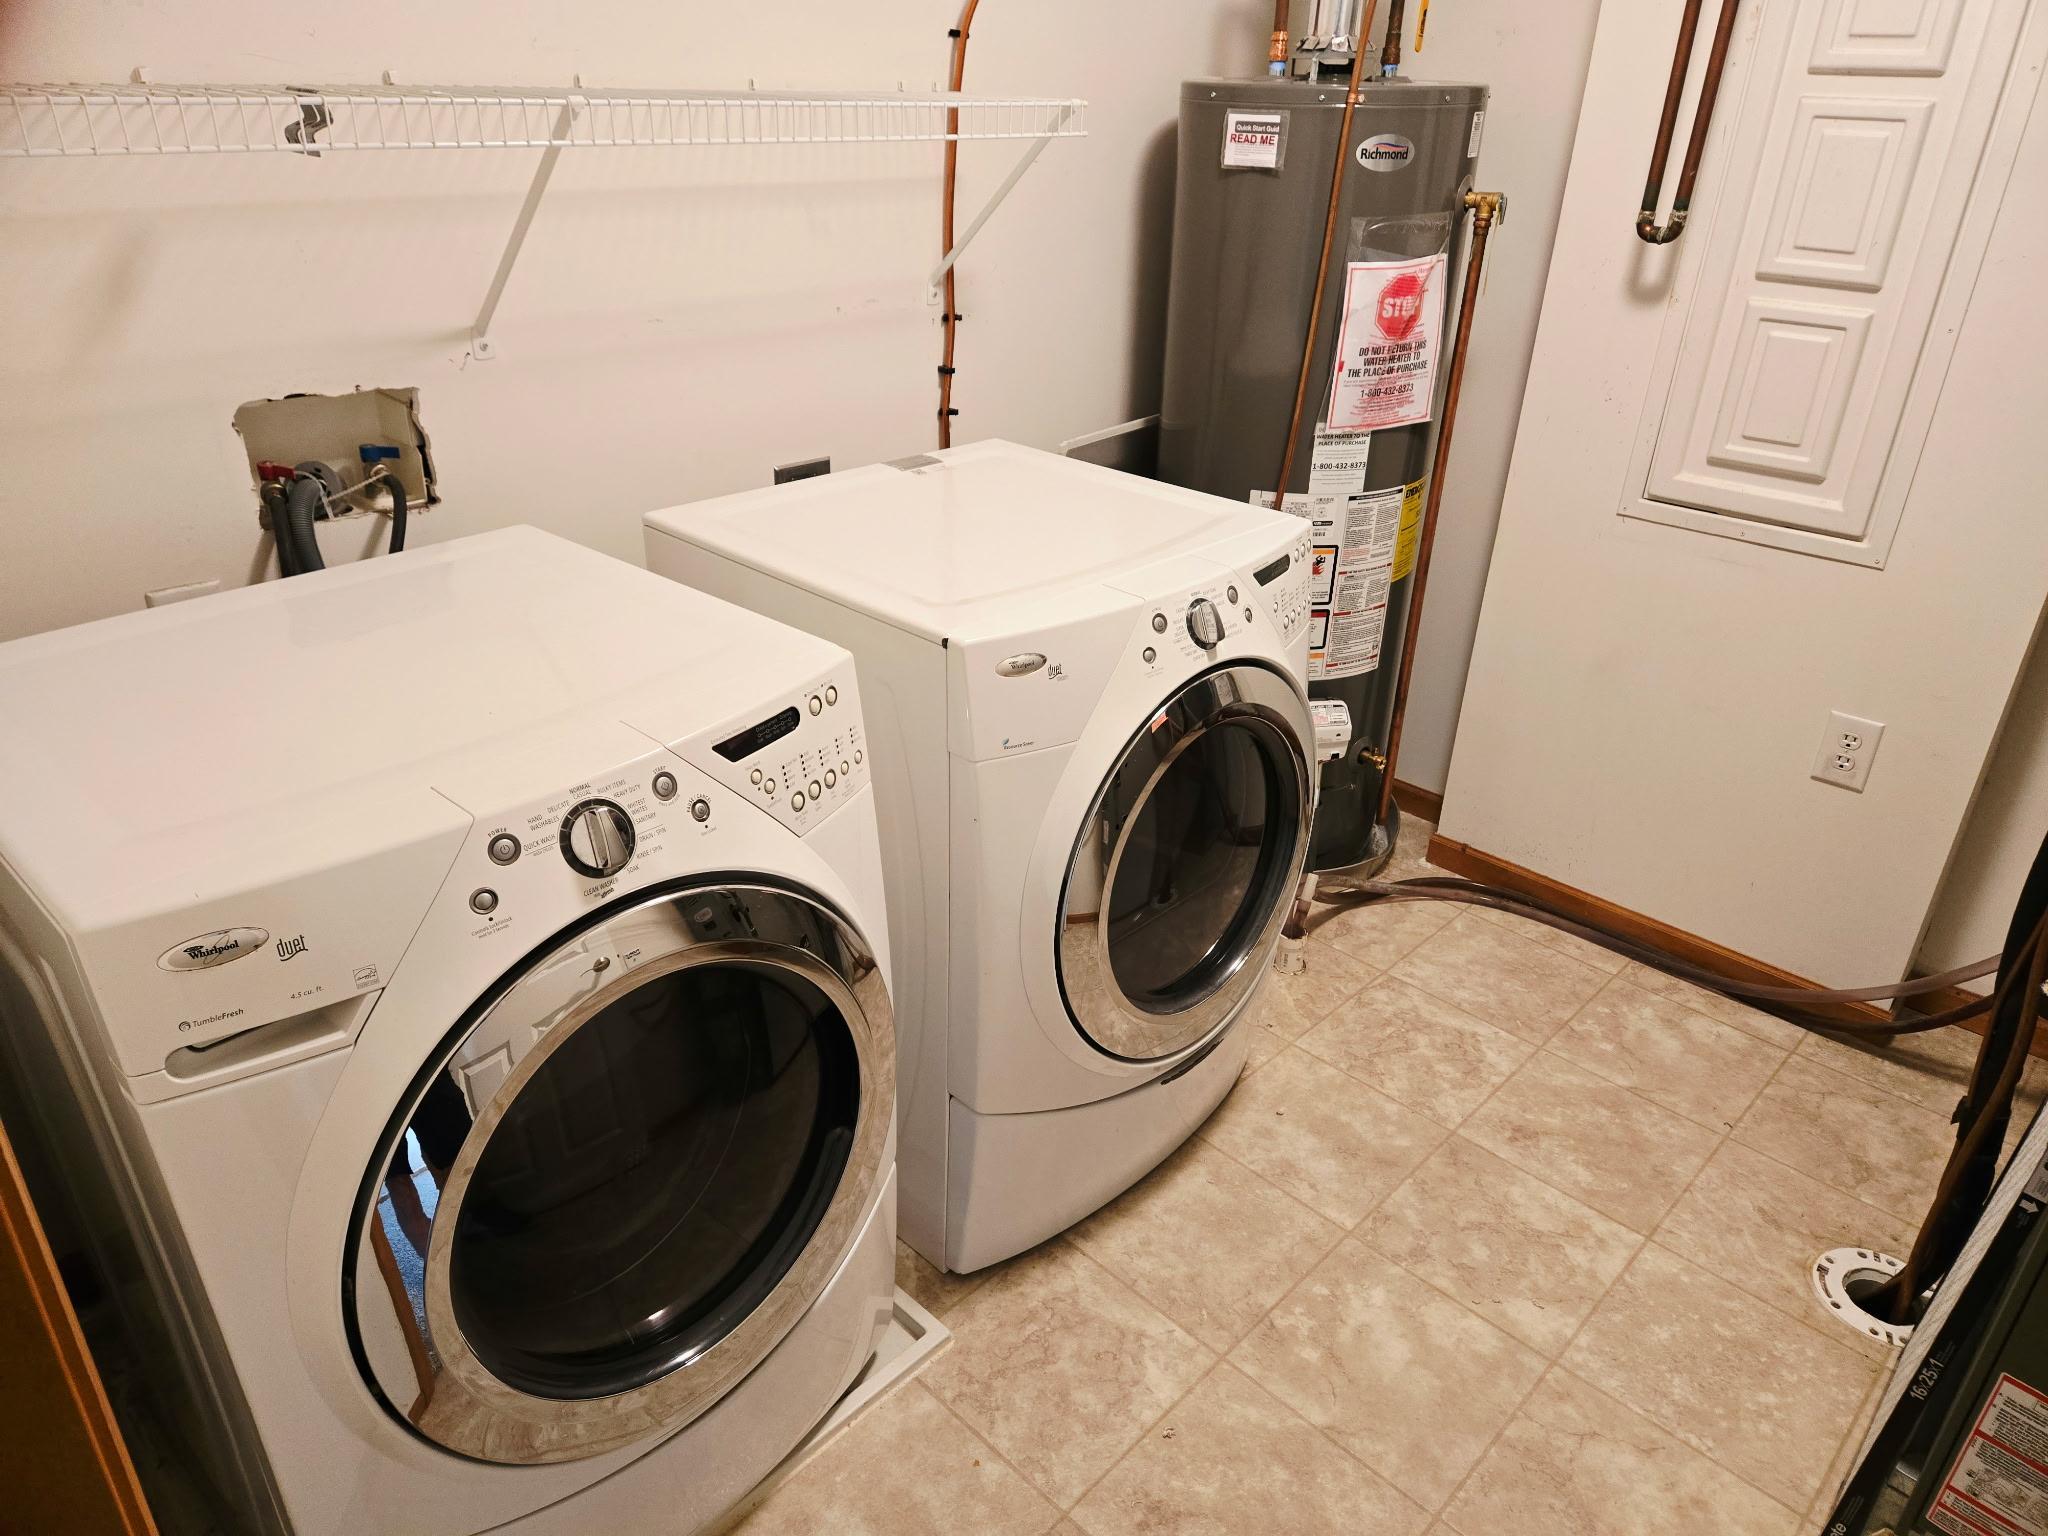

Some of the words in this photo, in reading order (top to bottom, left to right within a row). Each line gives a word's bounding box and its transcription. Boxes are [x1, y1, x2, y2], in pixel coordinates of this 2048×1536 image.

[1230, 133, 1257, 144] READ
[1260, 135, 1276, 145] ME
[1360, 146, 1409, 160] Richmond
[1359, 347, 1369, 356] DO
[1370, 345, 1387, 355] NOT
[1363, 356, 1387, 366] WATER
[1388, 353, 1412, 365] HEATER
[1413, 351, 1421, 360] TO
[1347, 369, 1363, 378] THE
[1363, 367, 1385, 377] PLACE
[1386, 365, 1396, 375] OF
[1396, 360, 1428, 374] PURCHASE
[1361, 383, 1414, 398] 1-800-432-8373
[1312, 461, 1367, 470] 1-800-432-8373
[568, 782, 592, 795] NORMAL
[628, 783, 641, 794] DUTY
[547, 800, 570, 814] DELICATE
[527, 814, 543, 825] HAND
[530, 815, 560, 831] WASHABLES
[487, 827, 508, 838] POWER
[523, 841, 540, 852] QUICK
[541, 833, 556, 844] WASH
[583, 885, 599, 897] CLEAN
[187, 940, 240, 960] Whirlpool
[276, 934, 309, 962] duet
[290, 991, 302, 1000] 4.5
[303, 989, 315, 997] cu.
[192, 1008, 244, 1028] TumbleFresh
